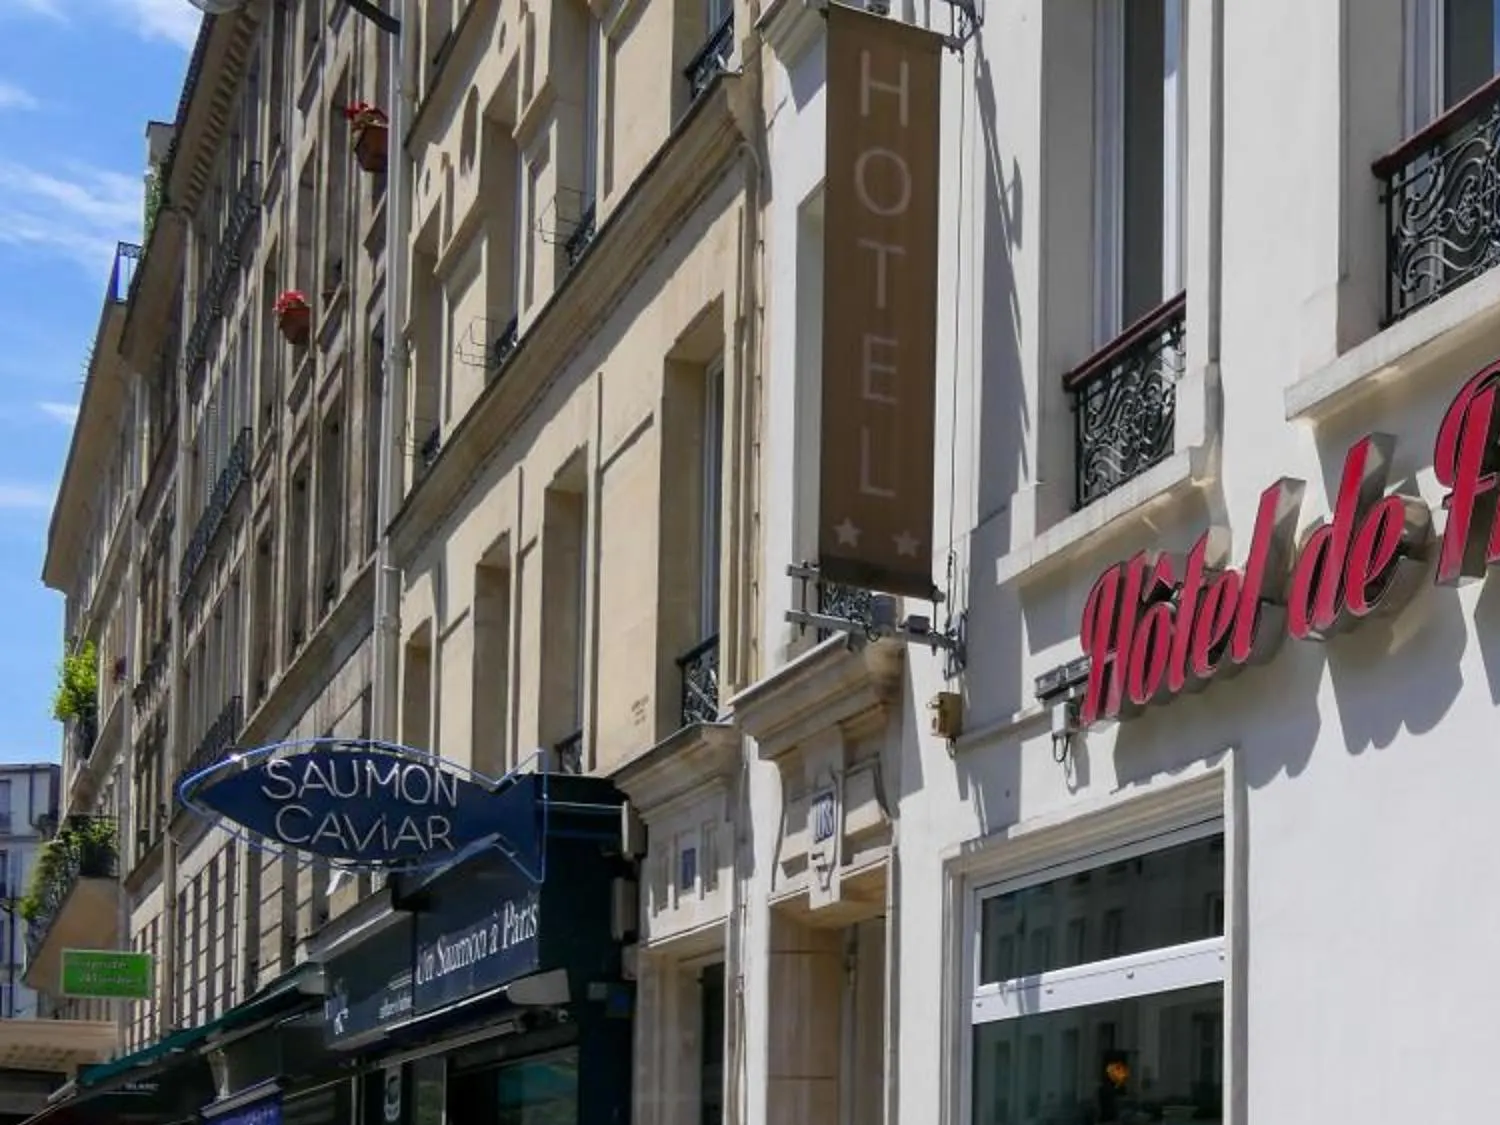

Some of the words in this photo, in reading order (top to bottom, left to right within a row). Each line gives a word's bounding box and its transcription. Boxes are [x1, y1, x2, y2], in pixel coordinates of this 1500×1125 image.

[854, 49, 912, 498] HOTEL
[1080, 475, 1284, 726] Hôtel
[1287, 436, 1408, 641] de
[261, 758, 459, 808] SAUMON
[436, 928, 487, 976] Saumon
[489, 909, 498, 954] à
[502, 899, 538, 948] Paris
